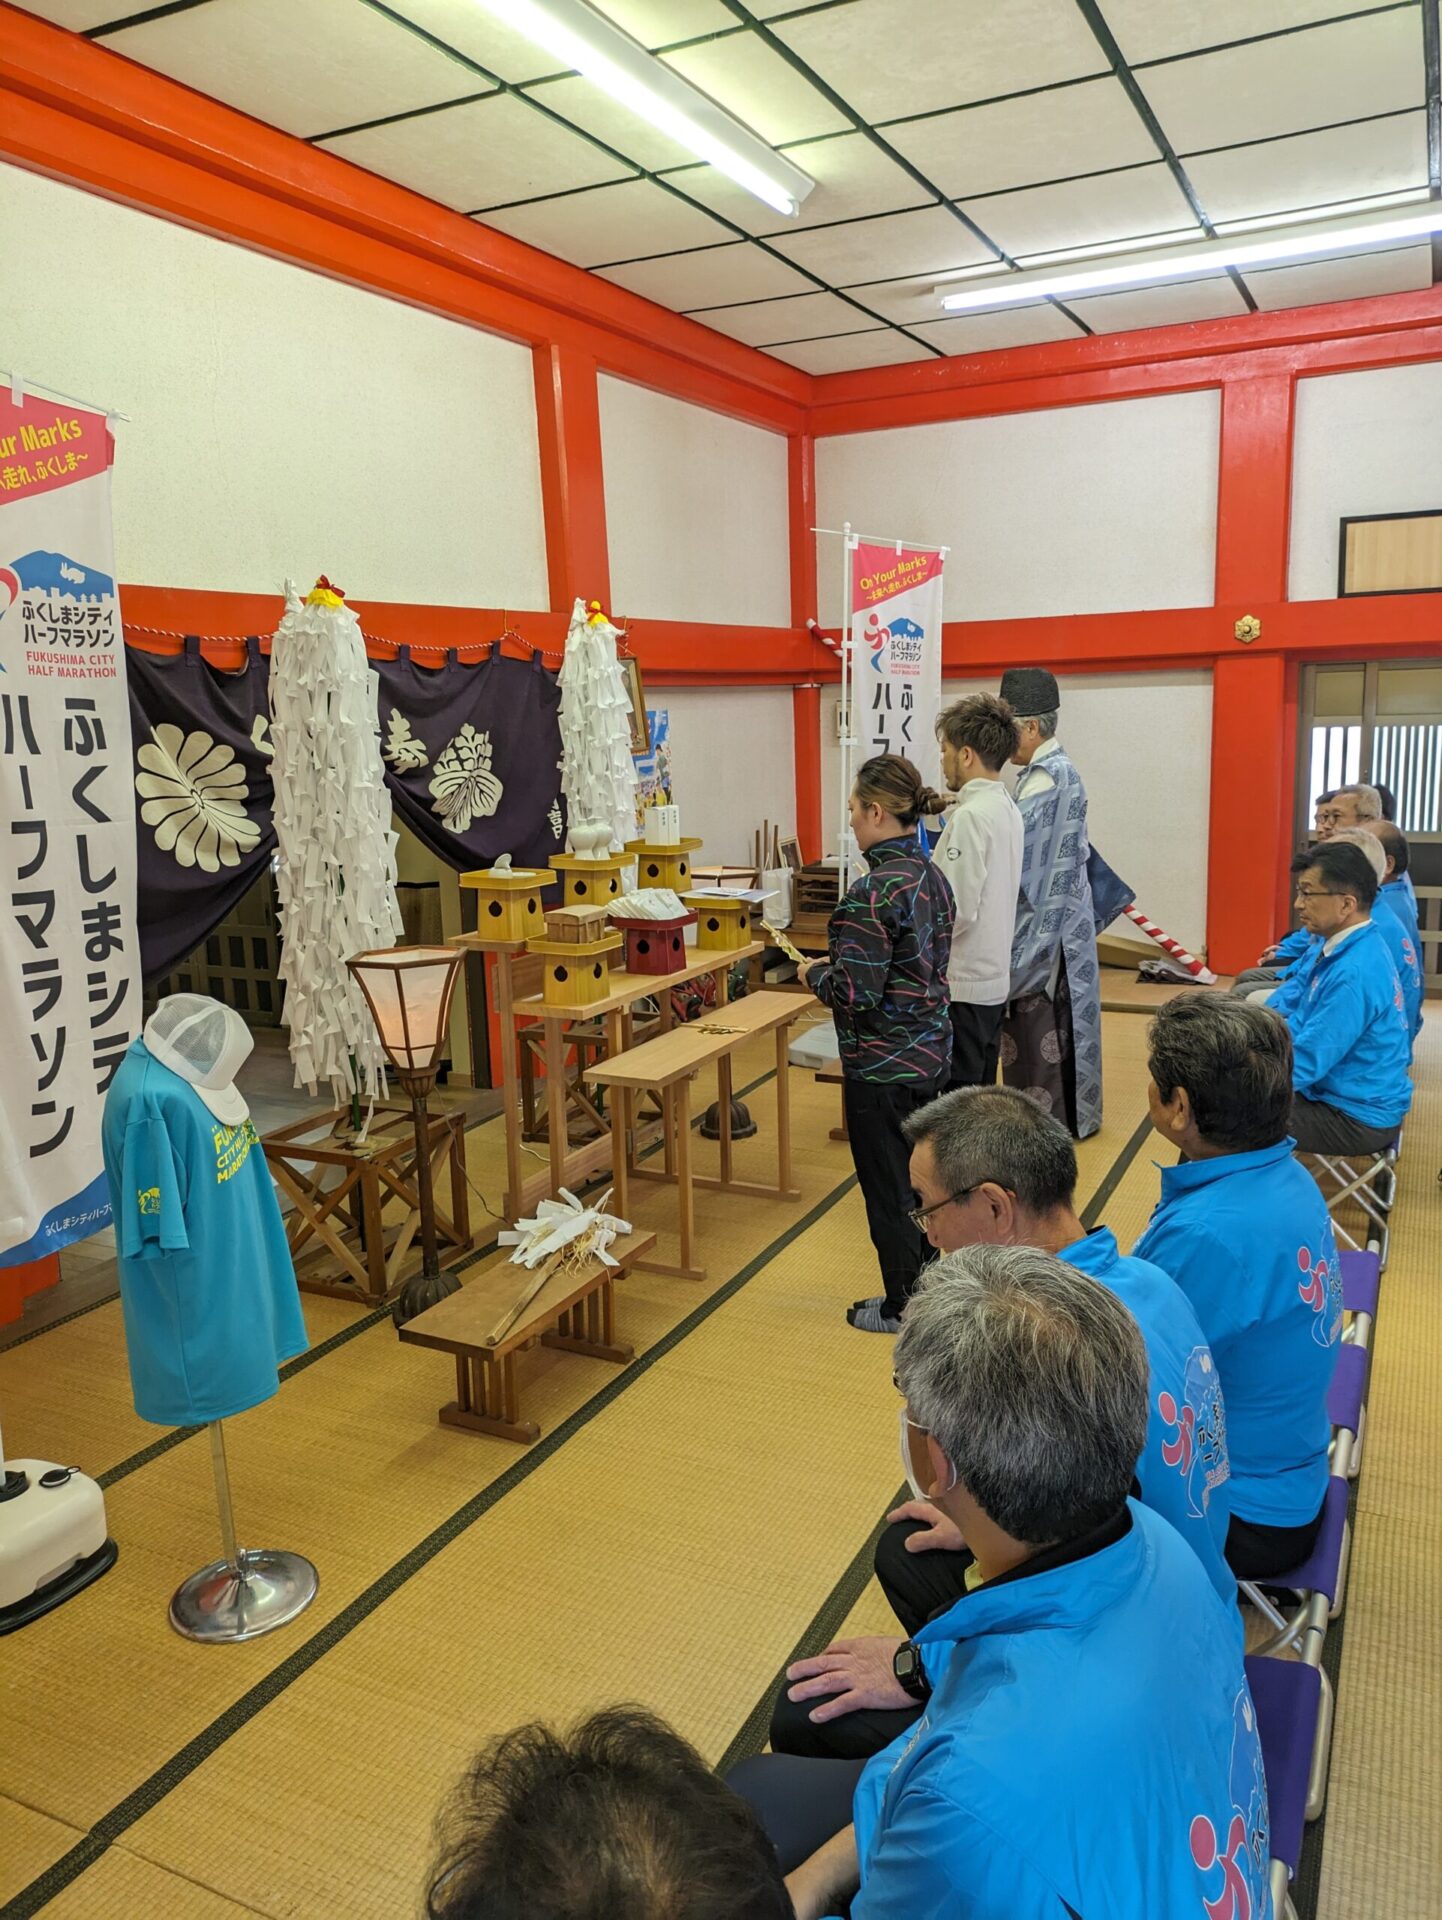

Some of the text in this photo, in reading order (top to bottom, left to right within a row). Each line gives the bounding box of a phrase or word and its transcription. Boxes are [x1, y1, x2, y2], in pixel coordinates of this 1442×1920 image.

[19, 416, 83, 452] Marks
[872, 571, 897, 586] Your
[897, 555, 928, 576] Marks
[22, 600, 114, 626] ふくしまシティ
[24, 623, 116, 649] ハーフマラソン
[26, 650, 116, 666] FUKUSHIMA CITY
[27, 664, 117, 680] HALF MARATHON
[1, 693, 75, 1158] ハーフマラソン
[44, 1202, 113, 1237] ふくしまシティハーフ
